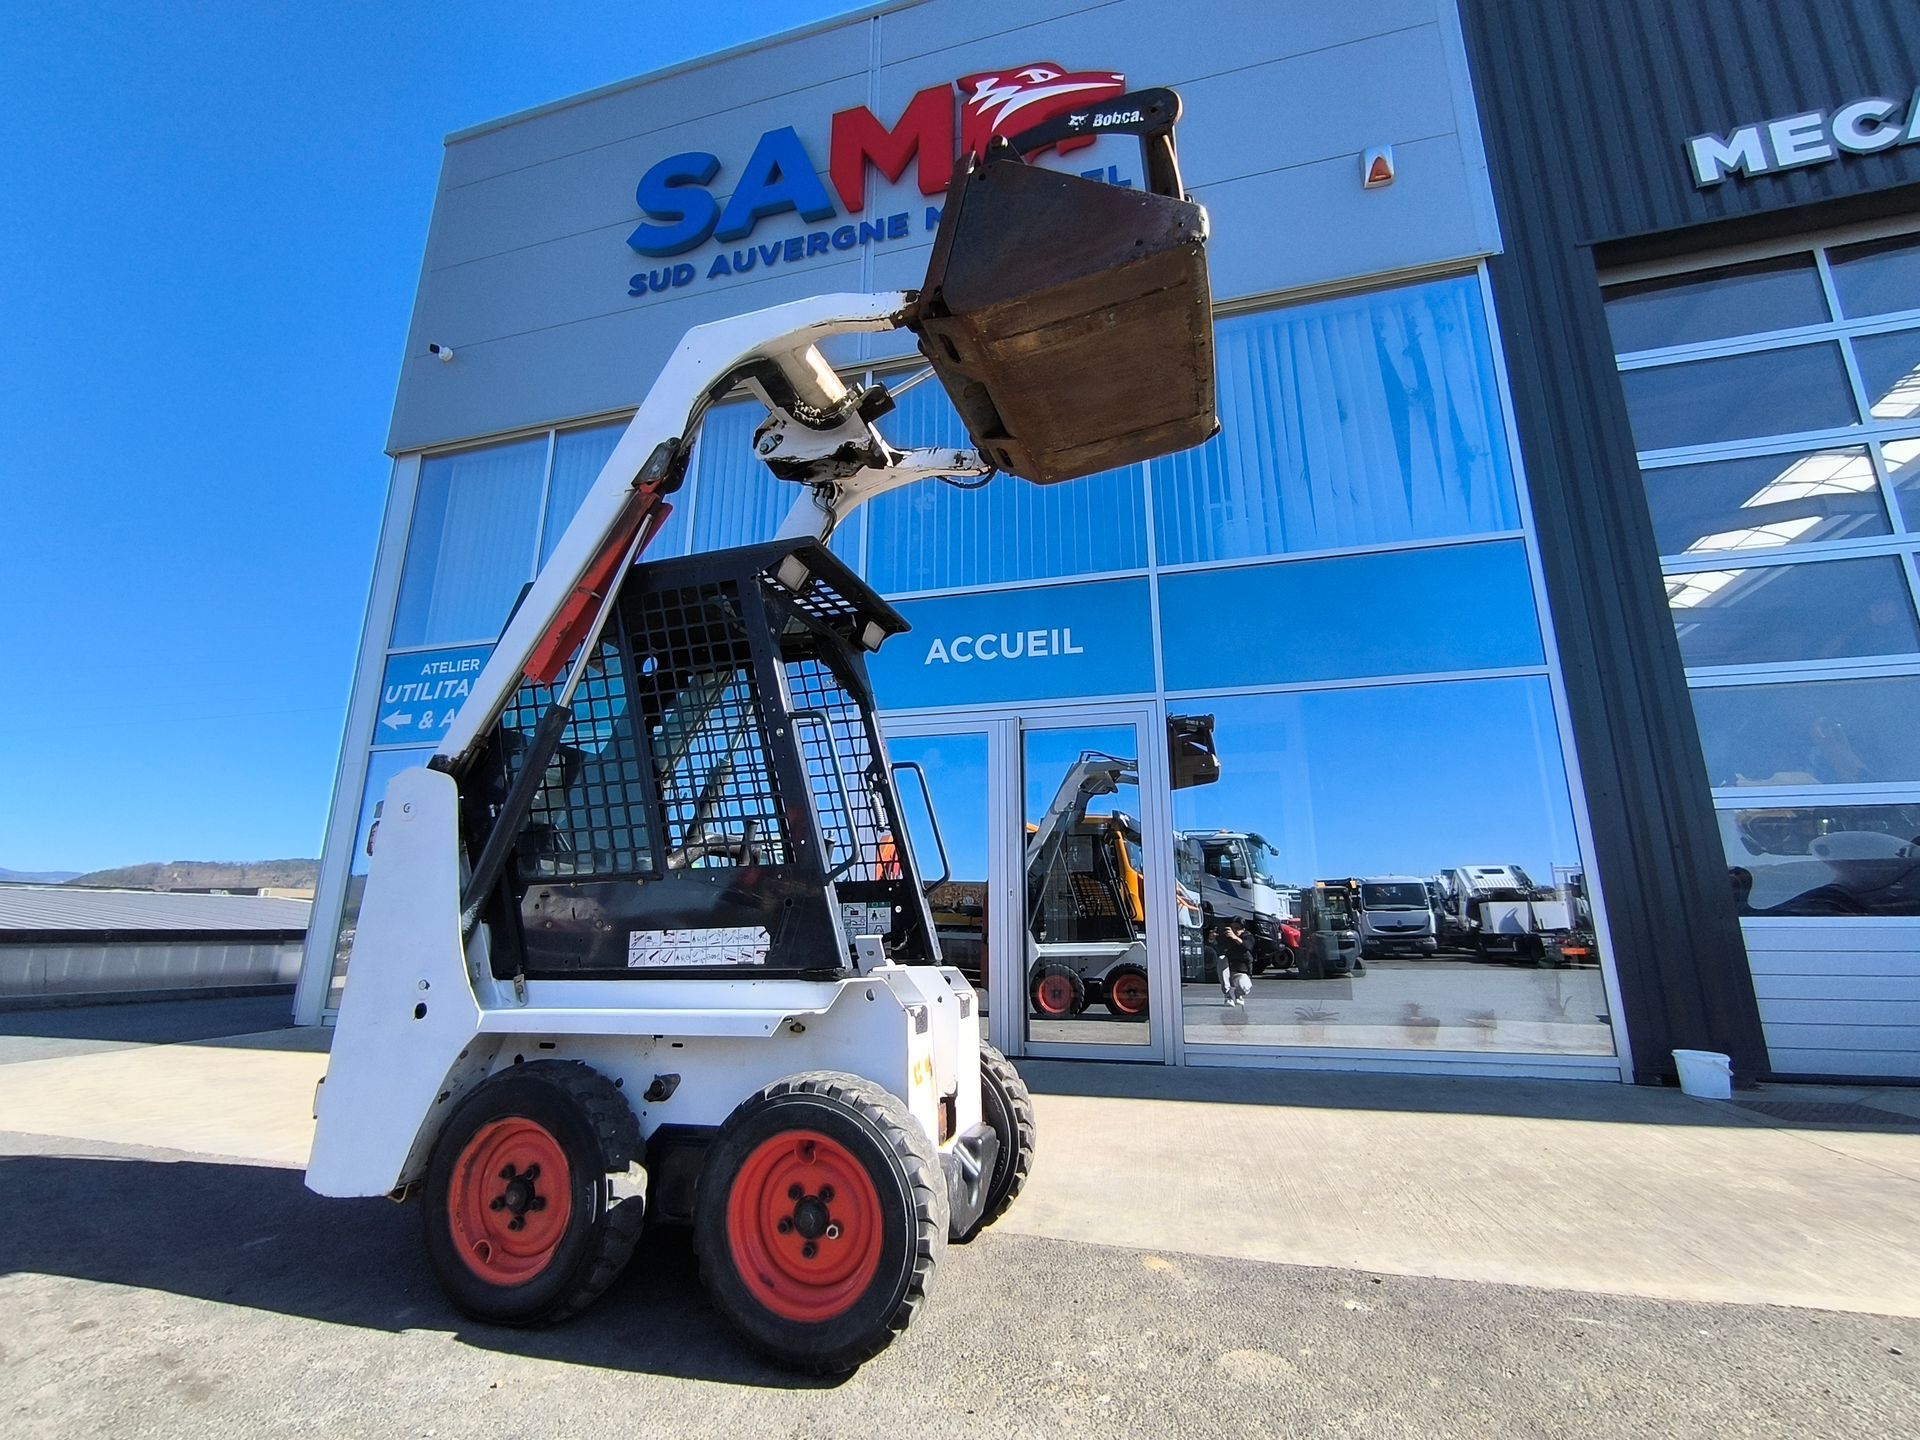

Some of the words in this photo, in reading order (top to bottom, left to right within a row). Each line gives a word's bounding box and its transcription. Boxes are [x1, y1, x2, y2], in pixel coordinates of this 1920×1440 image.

[1092, 109, 1145, 128] Bobca
[1690, 88, 1920, 182] MEC
[628, 263, 696, 297] SUD
[706, 212, 909, 279] AUVERGNE
[924, 627, 1084, 665] ACCUEIL
[420, 658, 480, 676] ATELIER
[385, 677, 480, 704] UTILITA
[438, 708, 456, 728] A
